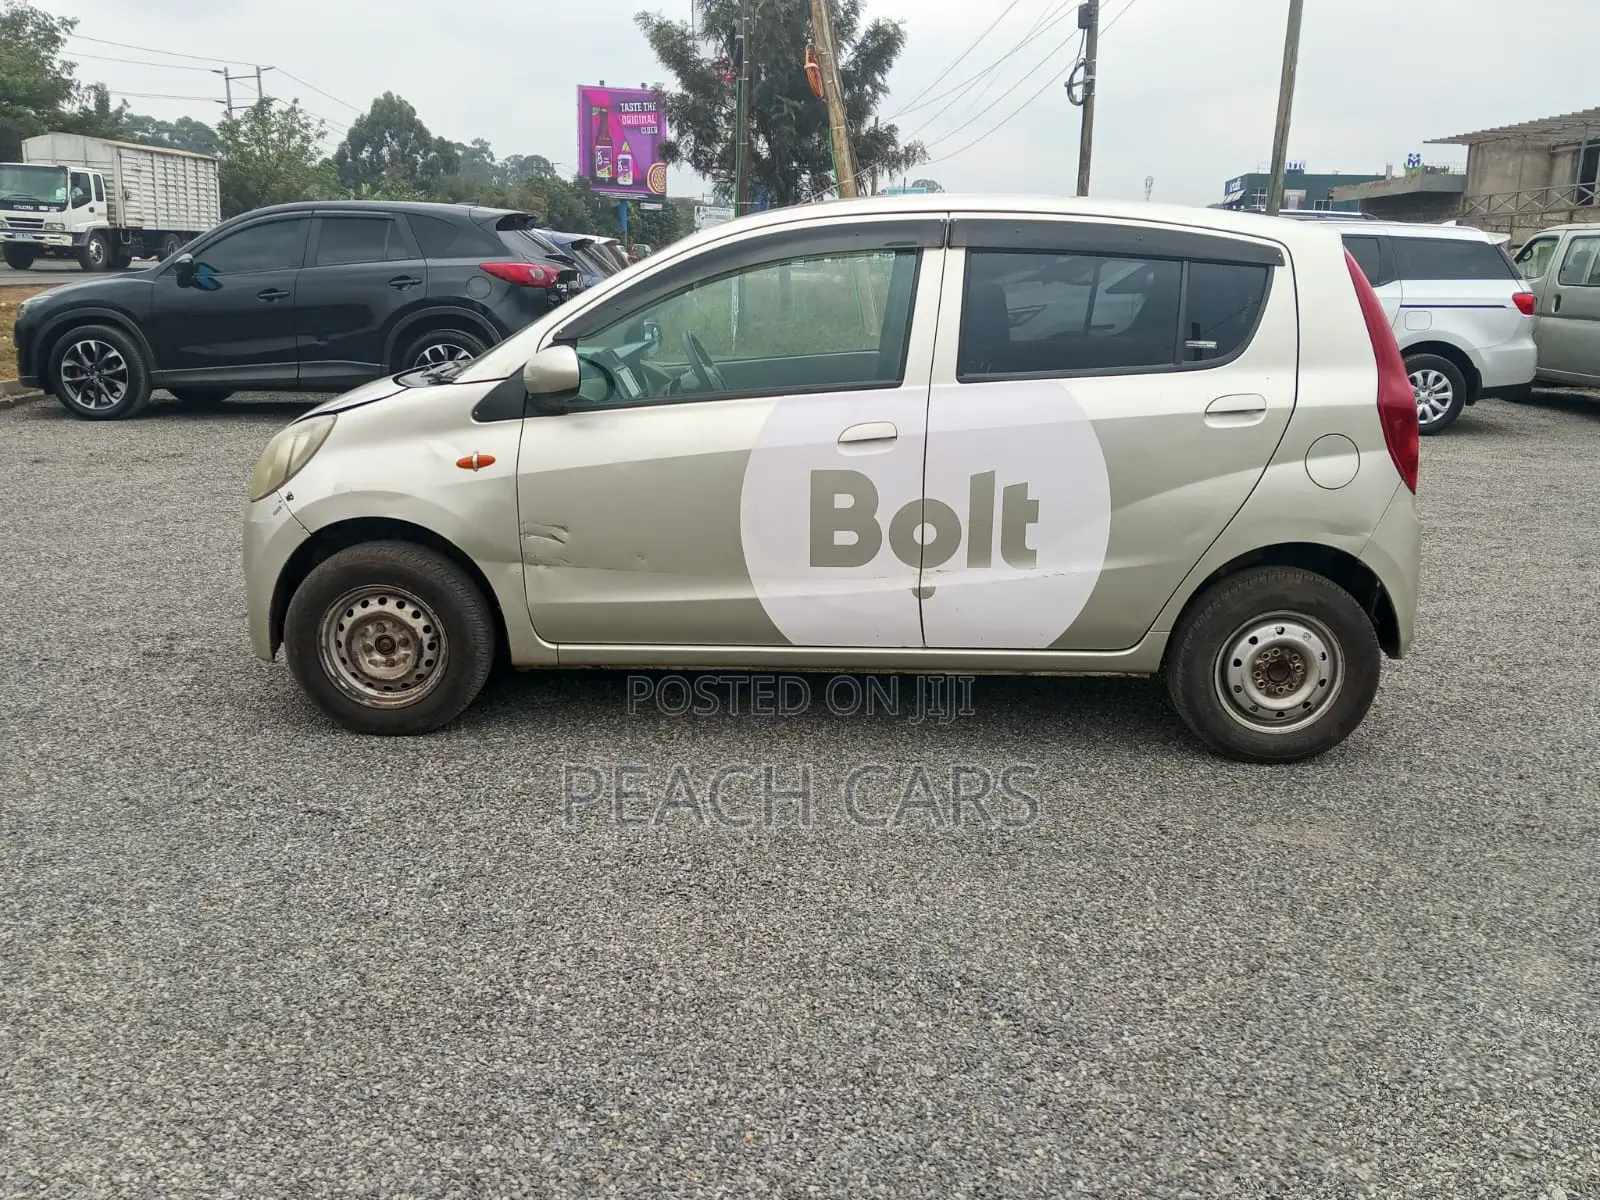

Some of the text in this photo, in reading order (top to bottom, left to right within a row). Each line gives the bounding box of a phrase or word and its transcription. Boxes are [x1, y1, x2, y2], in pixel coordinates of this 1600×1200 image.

[620, 102, 656, 112] TASTE THE
[621, 114, 657, 125] ORIGINAL
[640, 126, 658, 135] CIDER
[809, 469, 1040, 570] Bolt
